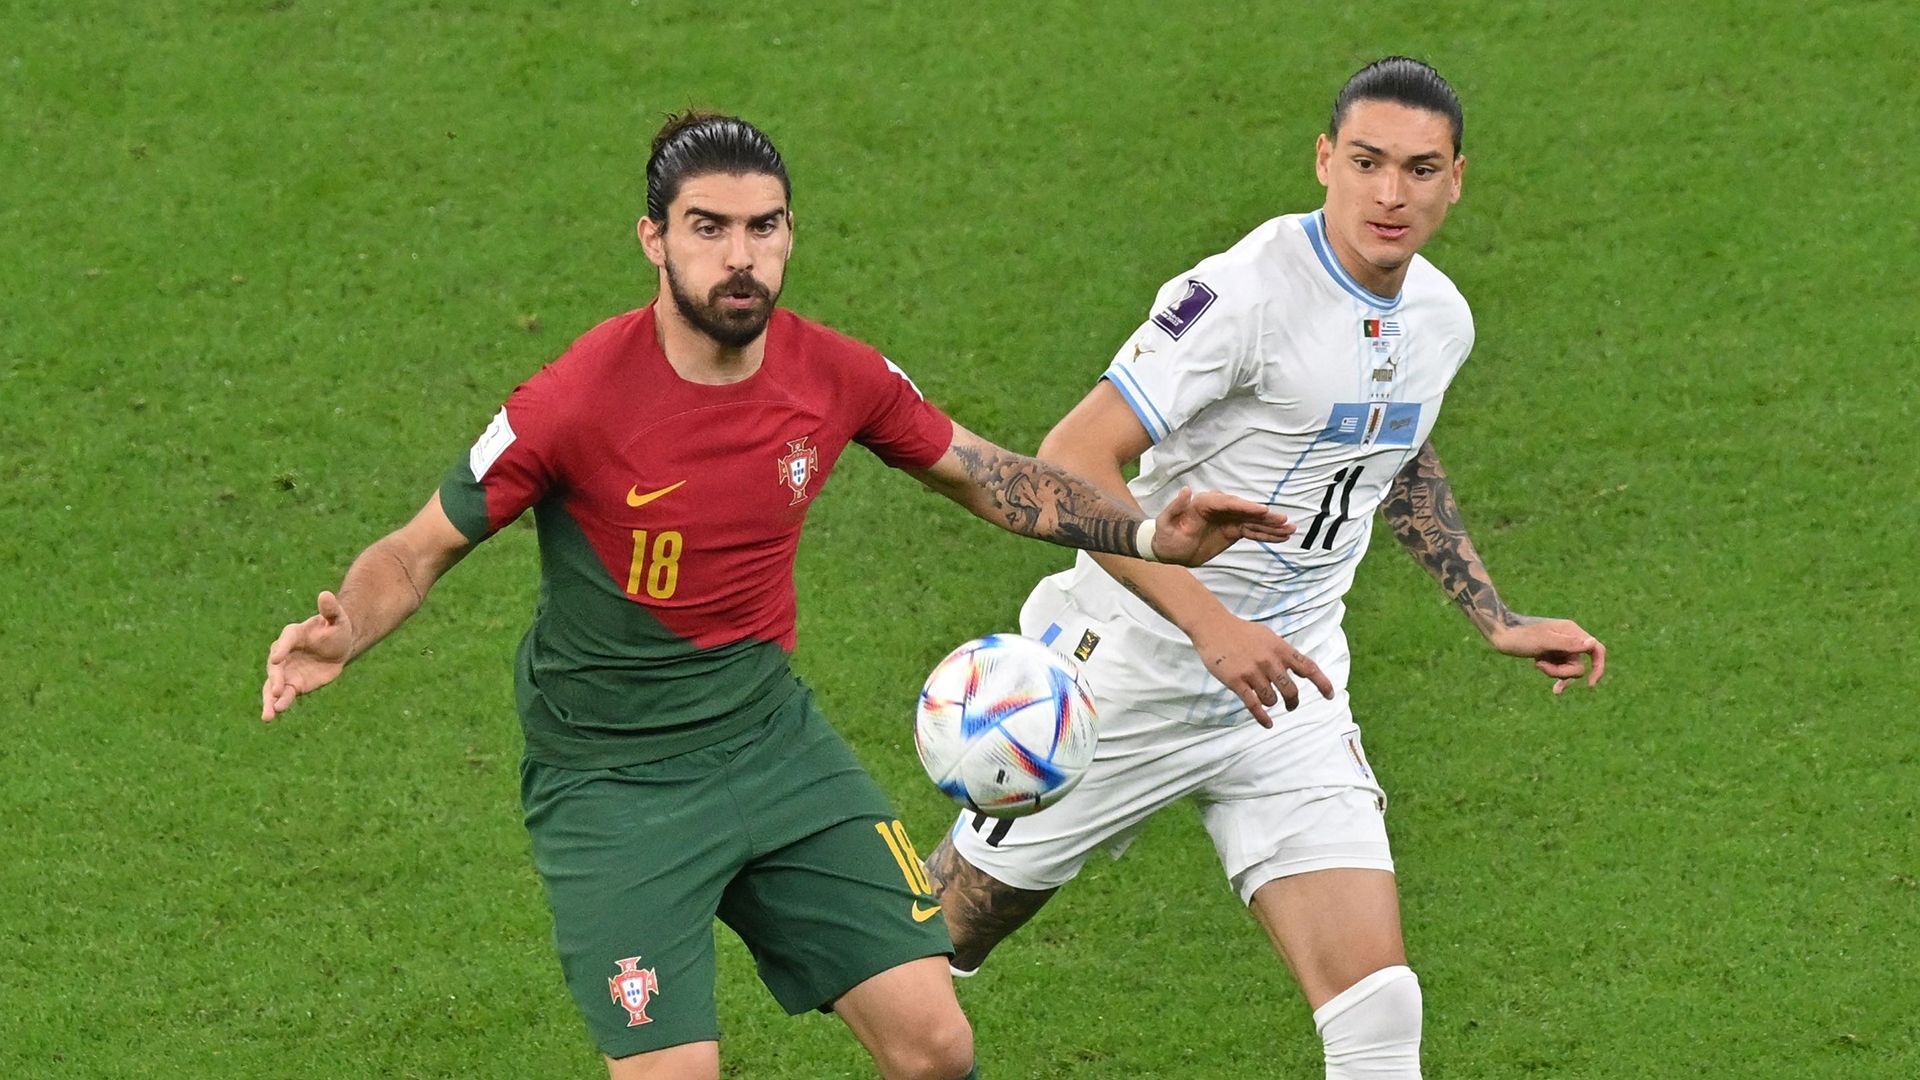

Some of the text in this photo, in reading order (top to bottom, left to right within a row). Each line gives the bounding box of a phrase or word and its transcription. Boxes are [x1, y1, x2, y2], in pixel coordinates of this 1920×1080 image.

[1300, 465, 1365, 551] 11
[626, 529, 683, 599] 18
[874, 819, 932, 896] 18
